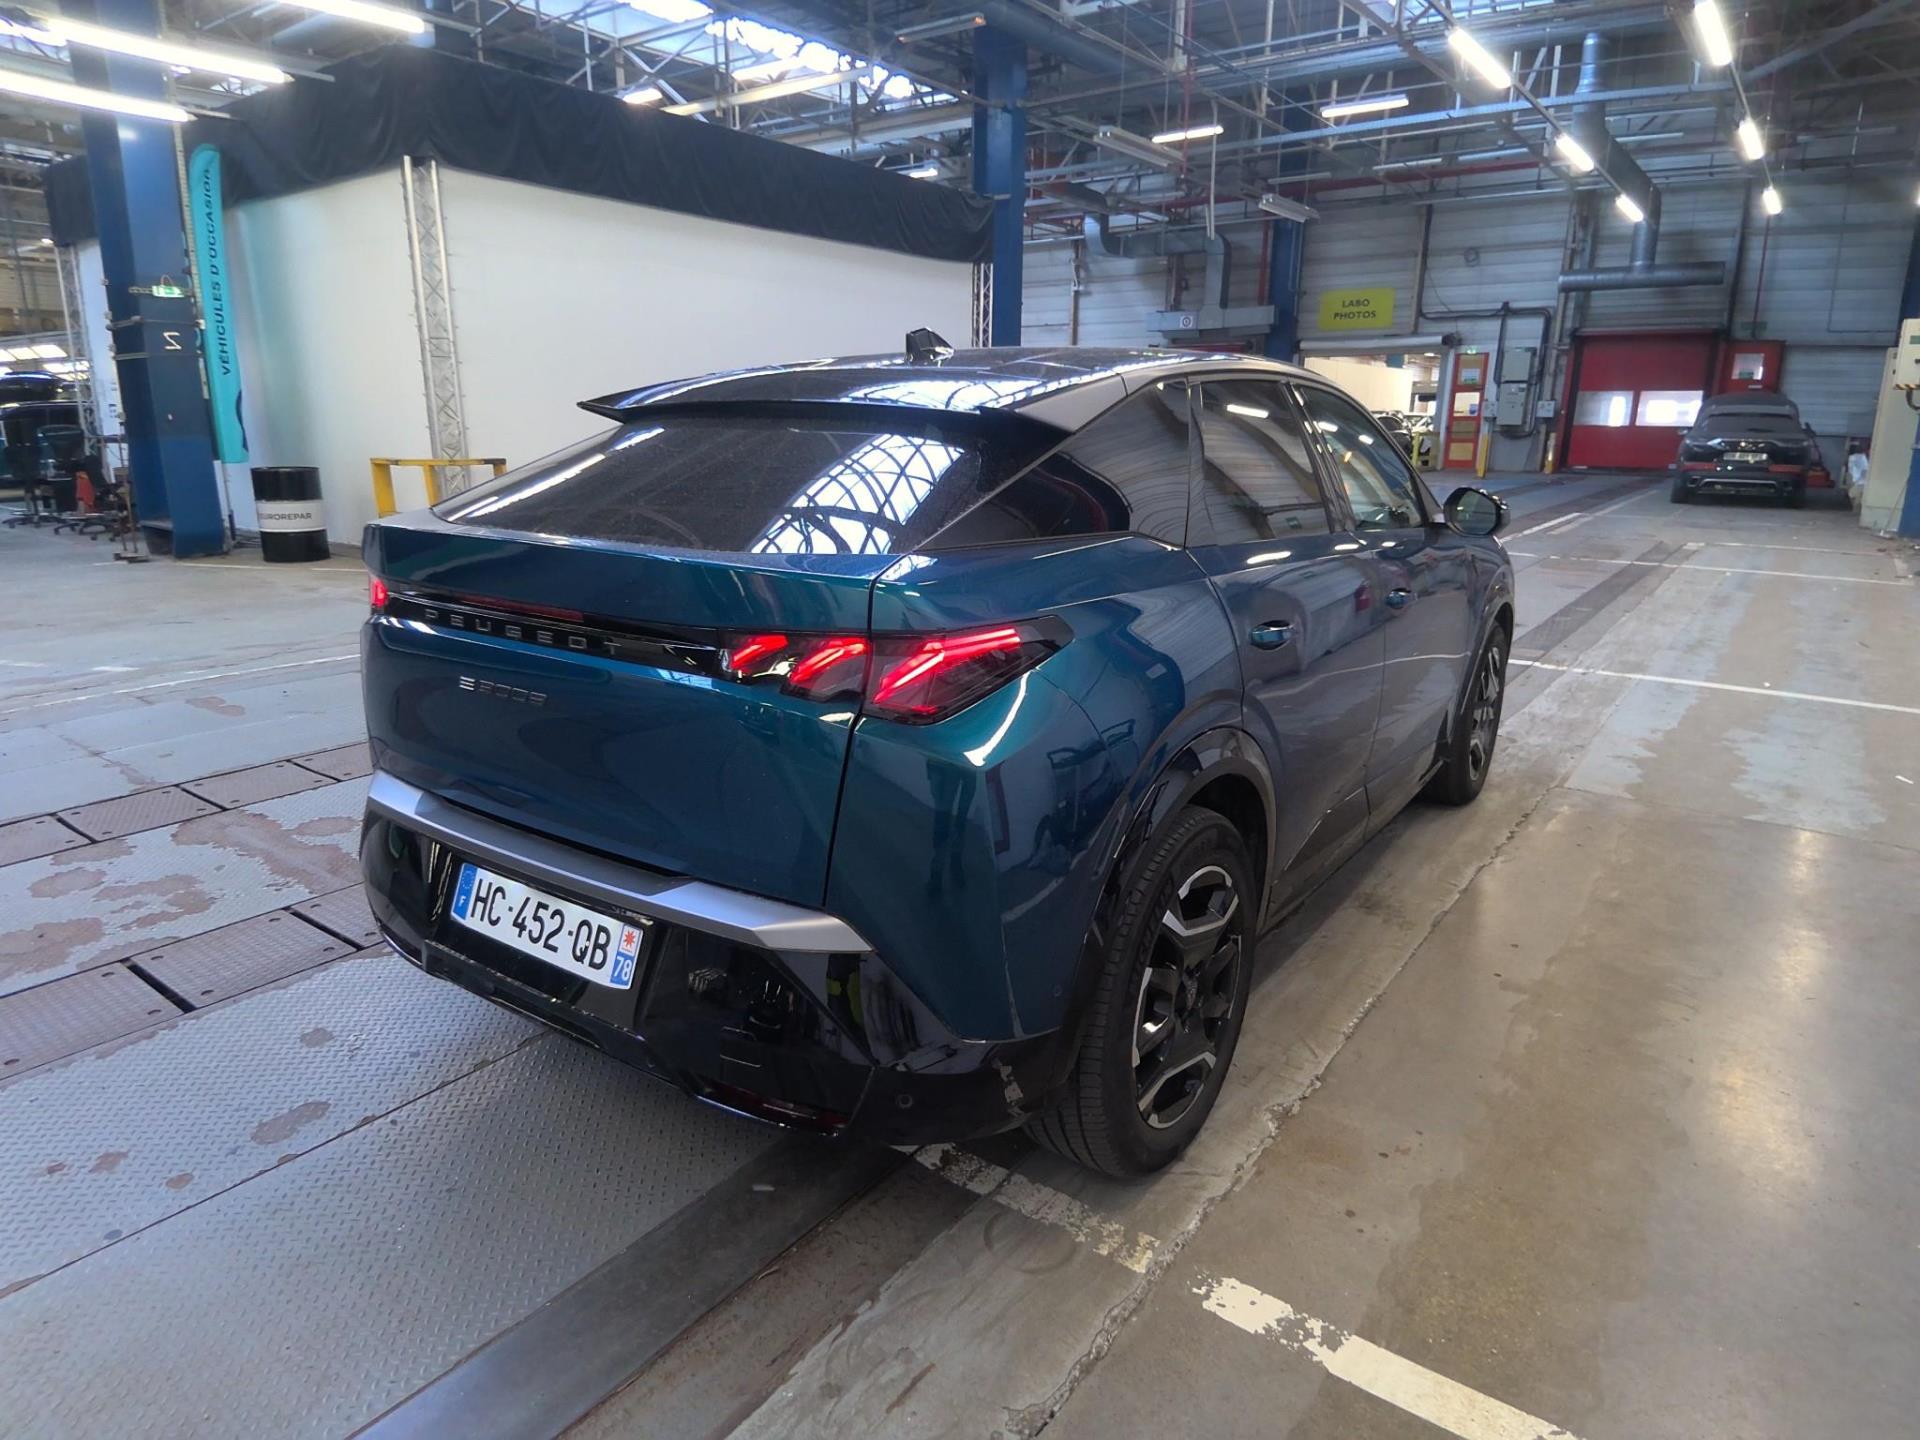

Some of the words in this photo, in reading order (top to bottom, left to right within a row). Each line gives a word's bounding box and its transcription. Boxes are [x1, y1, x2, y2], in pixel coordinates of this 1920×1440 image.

[203, 169, 219, 275] D'OCCASION
[211, 281, 231, 375] VÉHICULES
[1333, 310, 1377, 320] PHOTOS
[1342, 298, 1370, 308] LABO
[424, 608, 624, 655] PEUGEOT
[458, 896, 466, 907] F
[613, 956, 633, 981] 78
